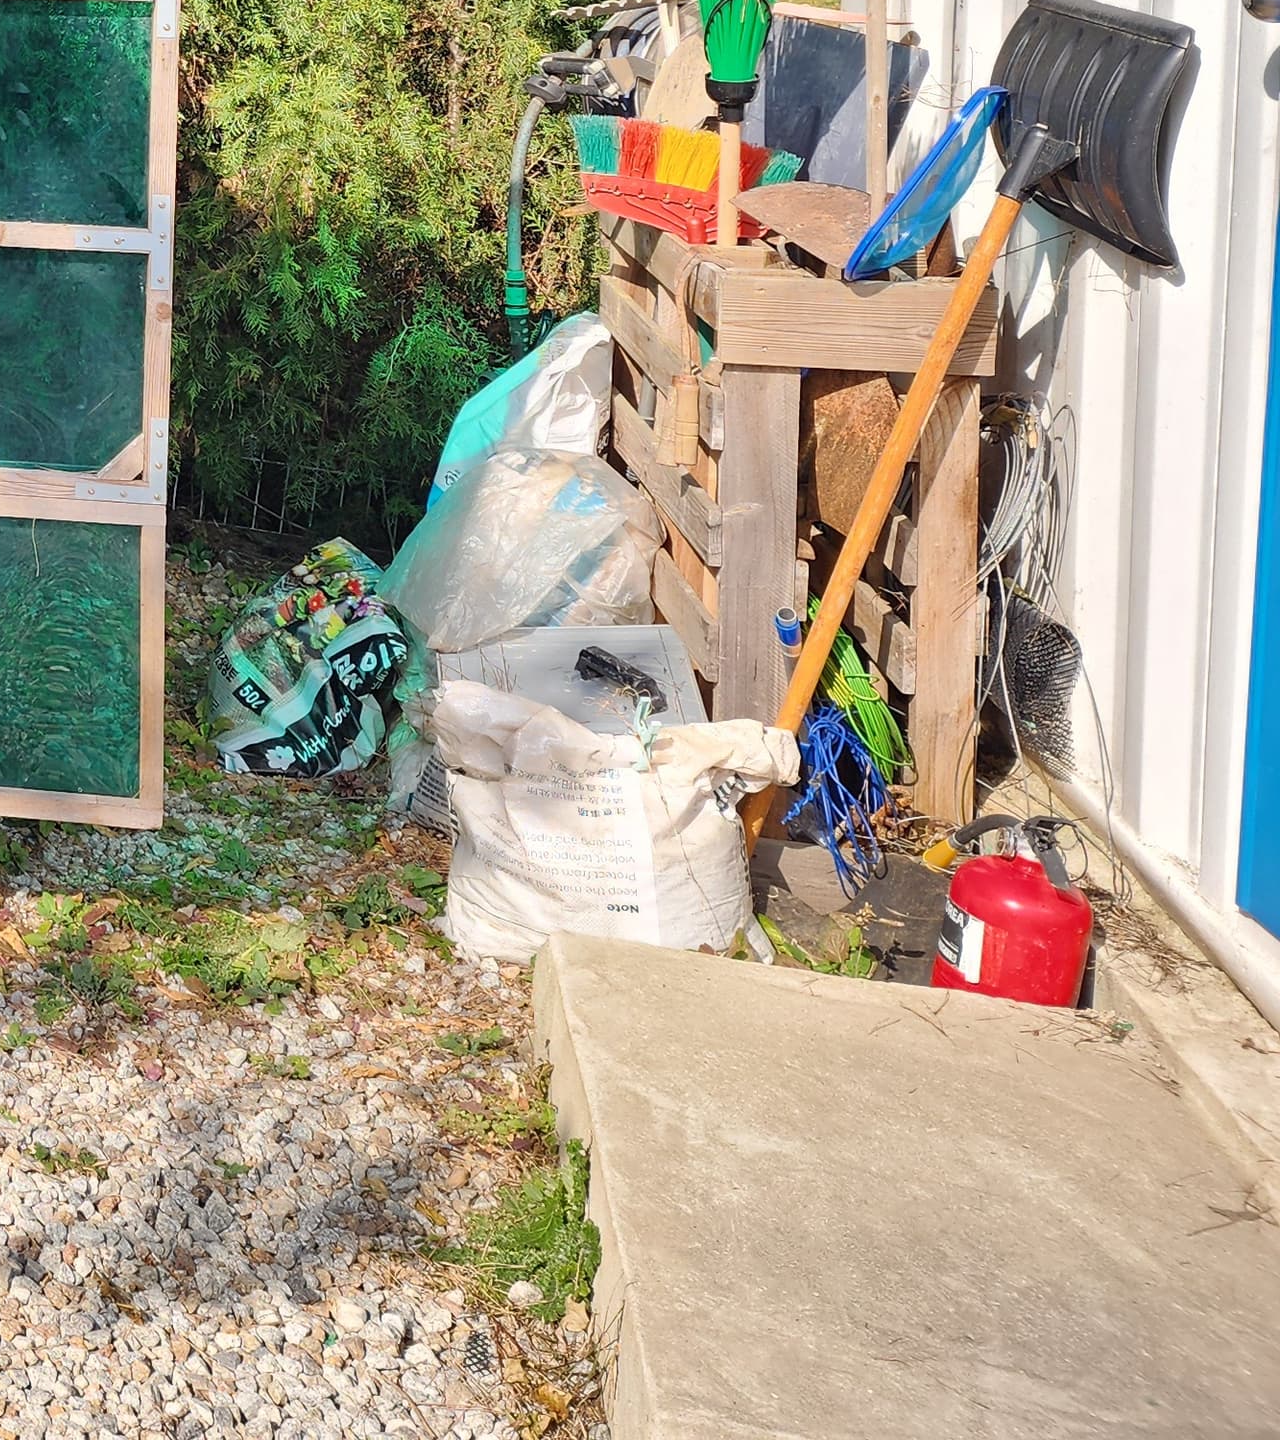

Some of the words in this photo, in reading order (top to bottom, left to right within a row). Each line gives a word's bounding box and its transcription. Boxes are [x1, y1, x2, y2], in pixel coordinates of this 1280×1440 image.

[595, 855, 636, 865] violent
[561, 869, 592, 880] from
[593, 871, 637, 881] Protect
[585, 886, 605, 896] the
[607, 885, 638, 897] Keep
[606, 903, 640, 914] Note
